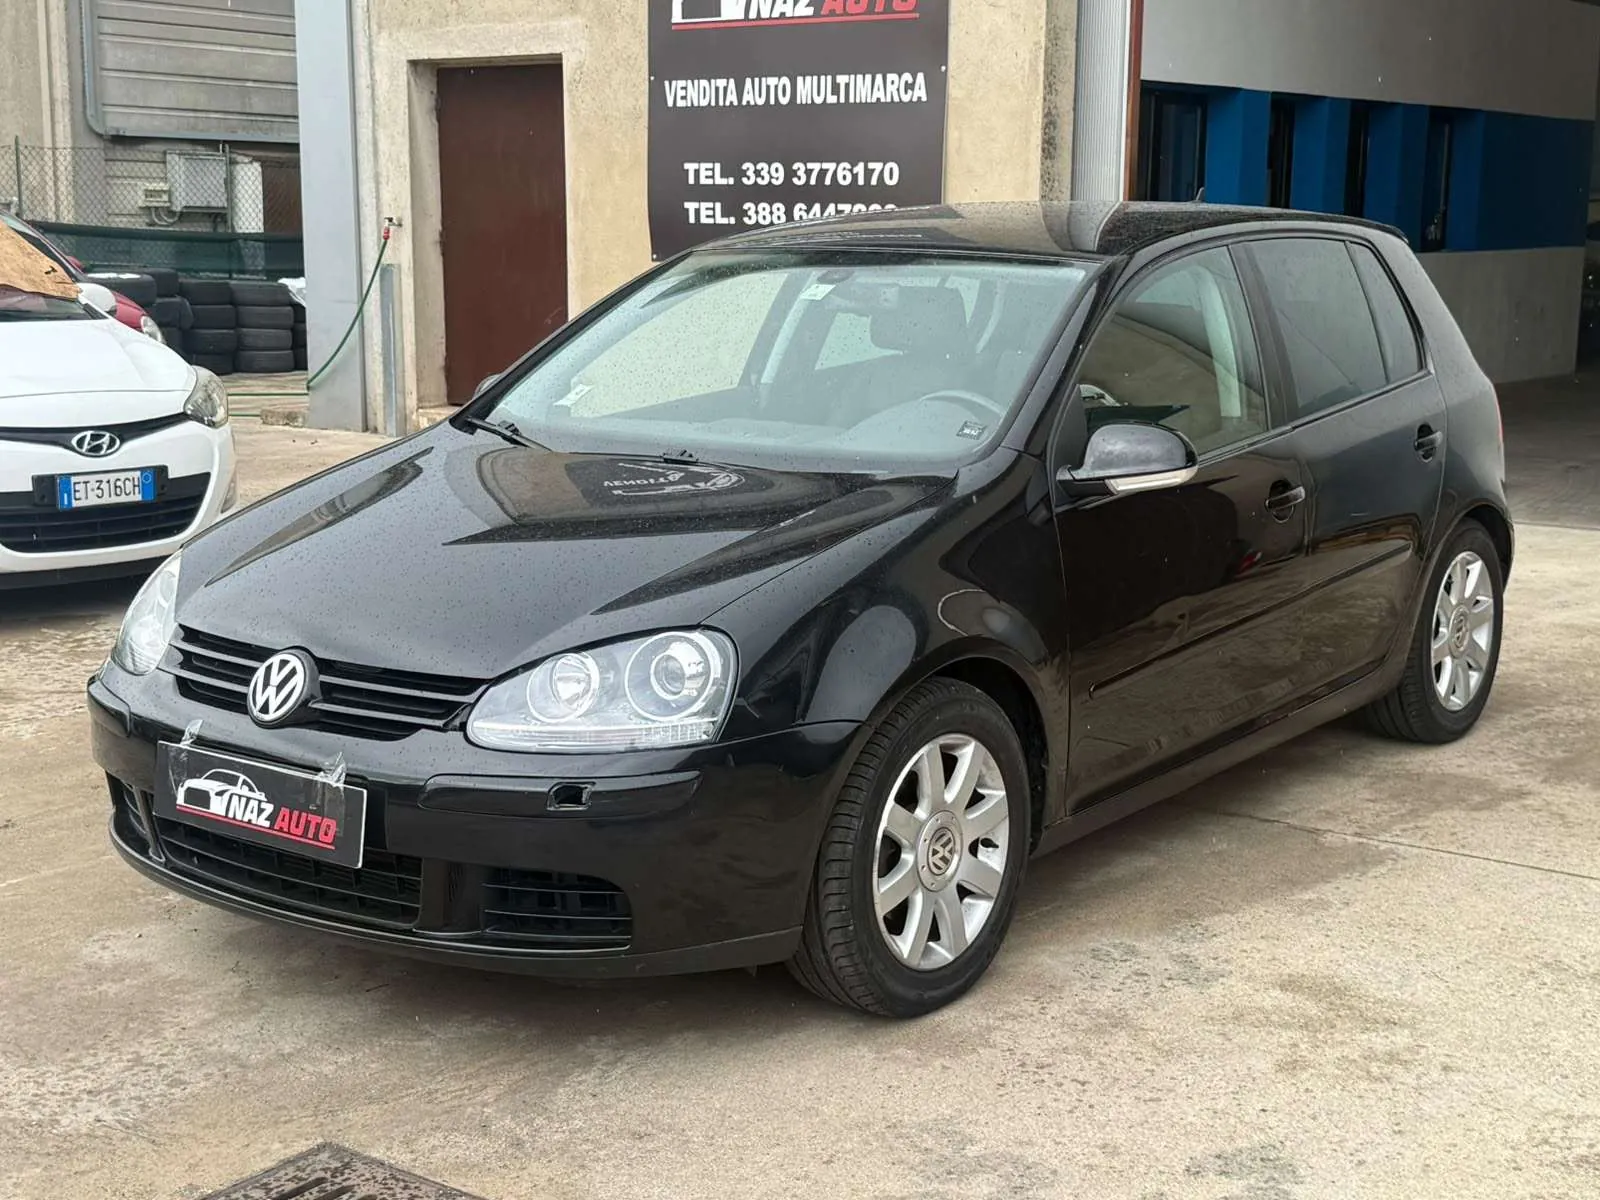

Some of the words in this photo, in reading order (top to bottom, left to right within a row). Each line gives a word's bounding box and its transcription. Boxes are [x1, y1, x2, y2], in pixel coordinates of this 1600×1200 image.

[664, 78, 738, 107] VENDITA
[742, 76, 791, 106] AUTO
[796, 72, 927, 105] MULTIMARCA
[683, 162, 734, 186] TEL.
[741, 162, 785, 186] 339
[792, 161, 900, 186] 3776170
[683, 202, 736, 224] TEL.
[742, 202, 786, 225] 388
[227, 793, 274, 828] NAZ
[273, 806, 338, 844] AUTO
